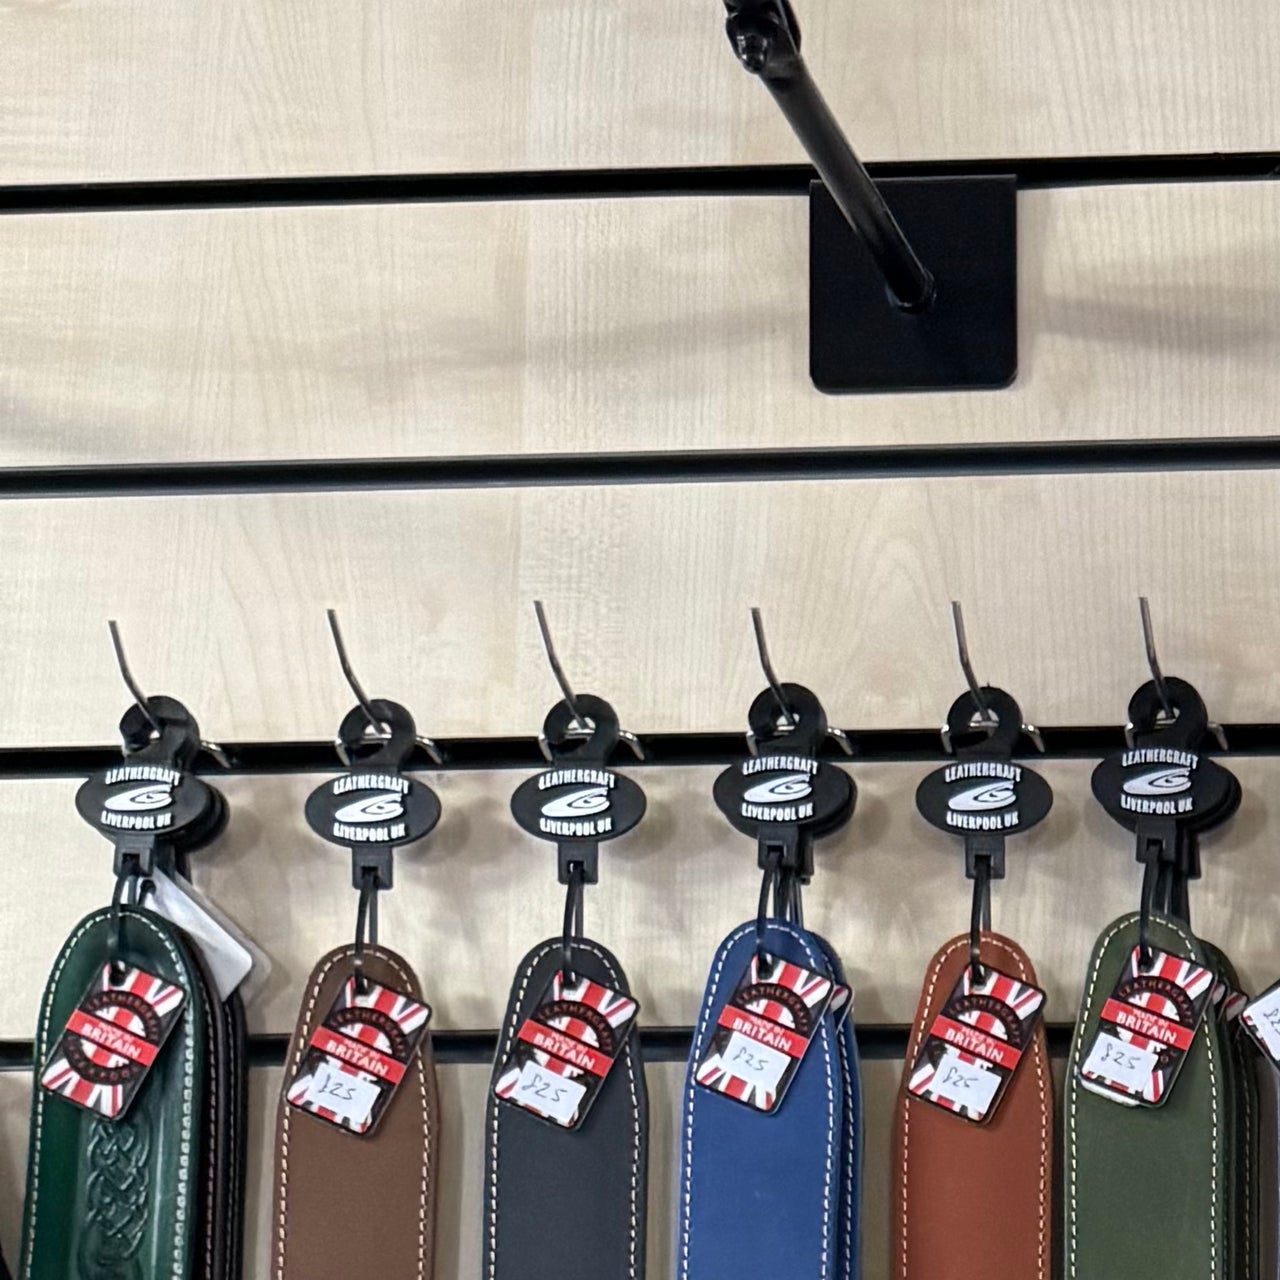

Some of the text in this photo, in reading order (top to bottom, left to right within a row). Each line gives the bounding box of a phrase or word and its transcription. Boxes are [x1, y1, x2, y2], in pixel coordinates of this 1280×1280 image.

[742, 756, 819, 775] LEATHERCRAFT
[1121, 748, 1199, 769] LEATHERCRAFT
[105, 766, 181, 787] LEATHERCRAFT
[538, 769, 616, 790] LEATHERCRAFT
[944, 762, 1022, 782] LEATHERCRAFT
[333, 774, 410, 795] LEATHERCRAFT
[741, 802, 814, 821] LIVERPOOL UK
[1120, 793, 1194, 815] LIVERPOOL UK
[101, 810, 172, 829] LIVERPOOL UK
[539, 817, 612, 836] LIVERPOOL UK
[946, 811, 1019, 830] LIVERPOOL UK
[333, 822, 407, 842] LIVERPOOL UK
[732, 1017, 793, 1052] BRITAIN
[1115, 1010, 1177, 1044] BRITAIN
[81, 1023, 143, 1059] BRITAIN
[533, 1032, 596, 1069] BRITAIN
[944, 1028, 1005, 1063] BRITAIN
[326, 1040, 389, 1076] BRITAIN
